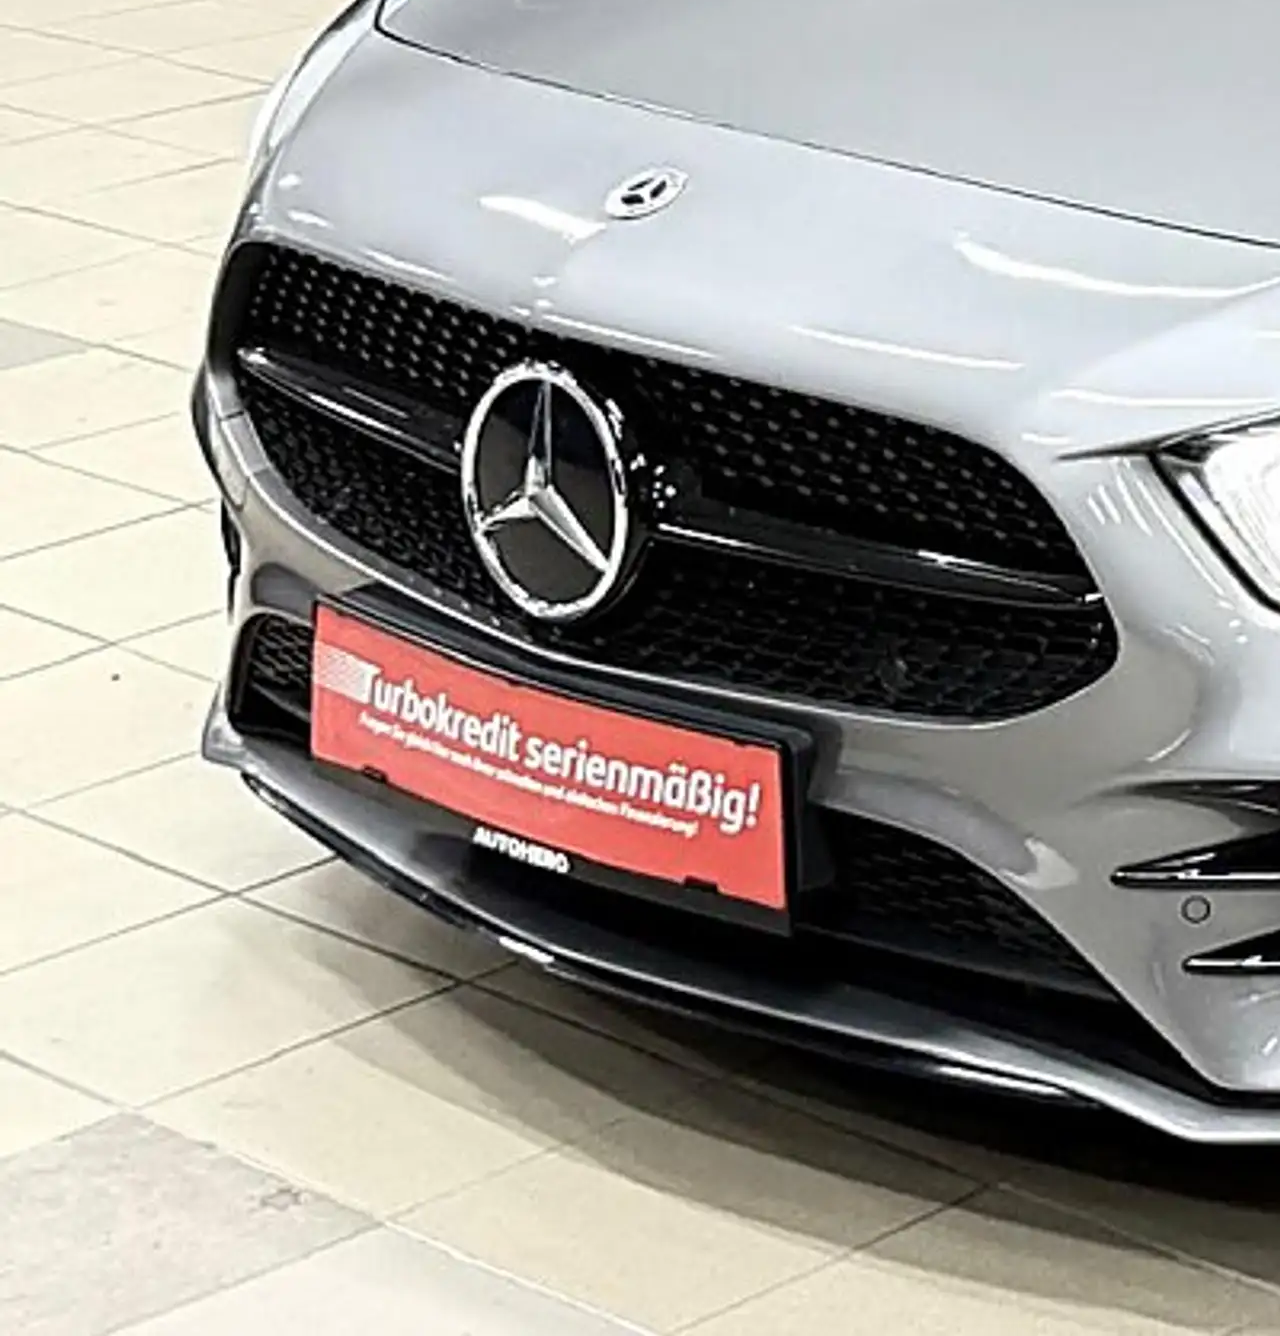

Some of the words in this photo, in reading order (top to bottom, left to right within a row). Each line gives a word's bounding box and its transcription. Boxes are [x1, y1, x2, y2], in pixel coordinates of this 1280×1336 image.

[360, 666, 523, 763] Turbokredit
[524, 736, 761, 832] serienmäßig!
[472, 826, 571, 873] AUTOHERO
